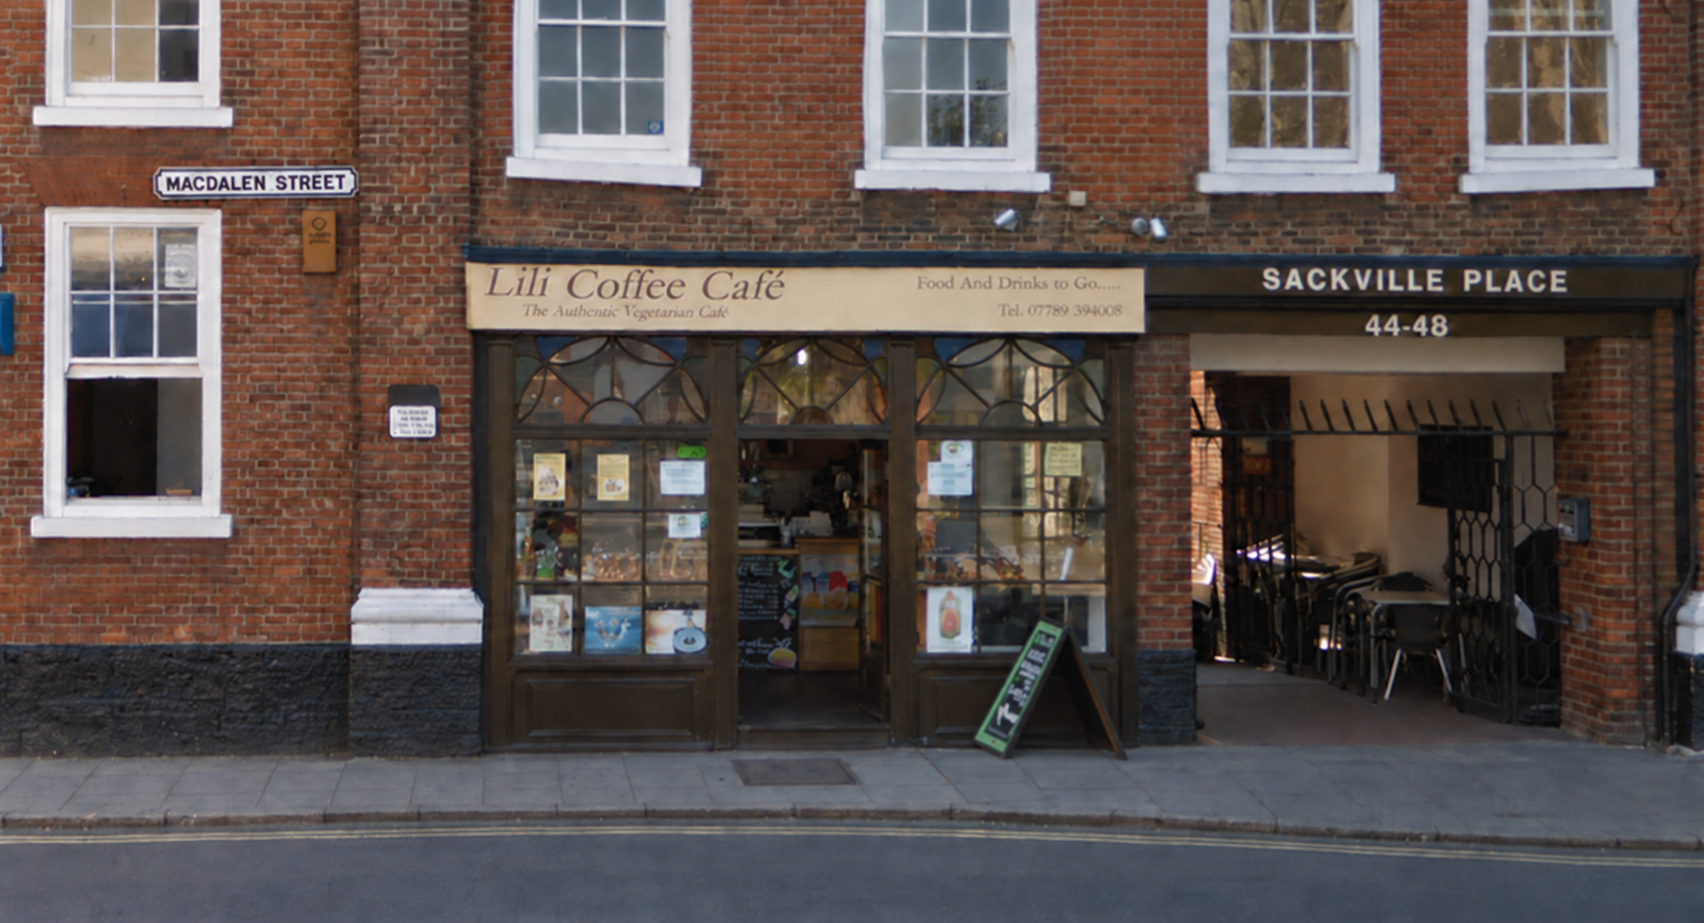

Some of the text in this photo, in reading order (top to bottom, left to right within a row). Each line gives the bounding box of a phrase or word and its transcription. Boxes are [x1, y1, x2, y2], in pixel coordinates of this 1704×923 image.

[275, 174, 346, 190] STREET
[484, 266, 785, 300] Lili Coffee Café
[917, 276, 955, 290] Food
[960, 277, 993, 290] And
[998, 276, 1048, 290] Drinks
[1054, 278, 1069, 290] to
[1262, 267, 1568, 292] SACKVILLE PLACE
[523, 303, 730, 322] The Authentic Vegetarian Café
[998, 303, 1123, 318] Tel. 07789 394008
[1365, 314, 1449, 336] 44-48
